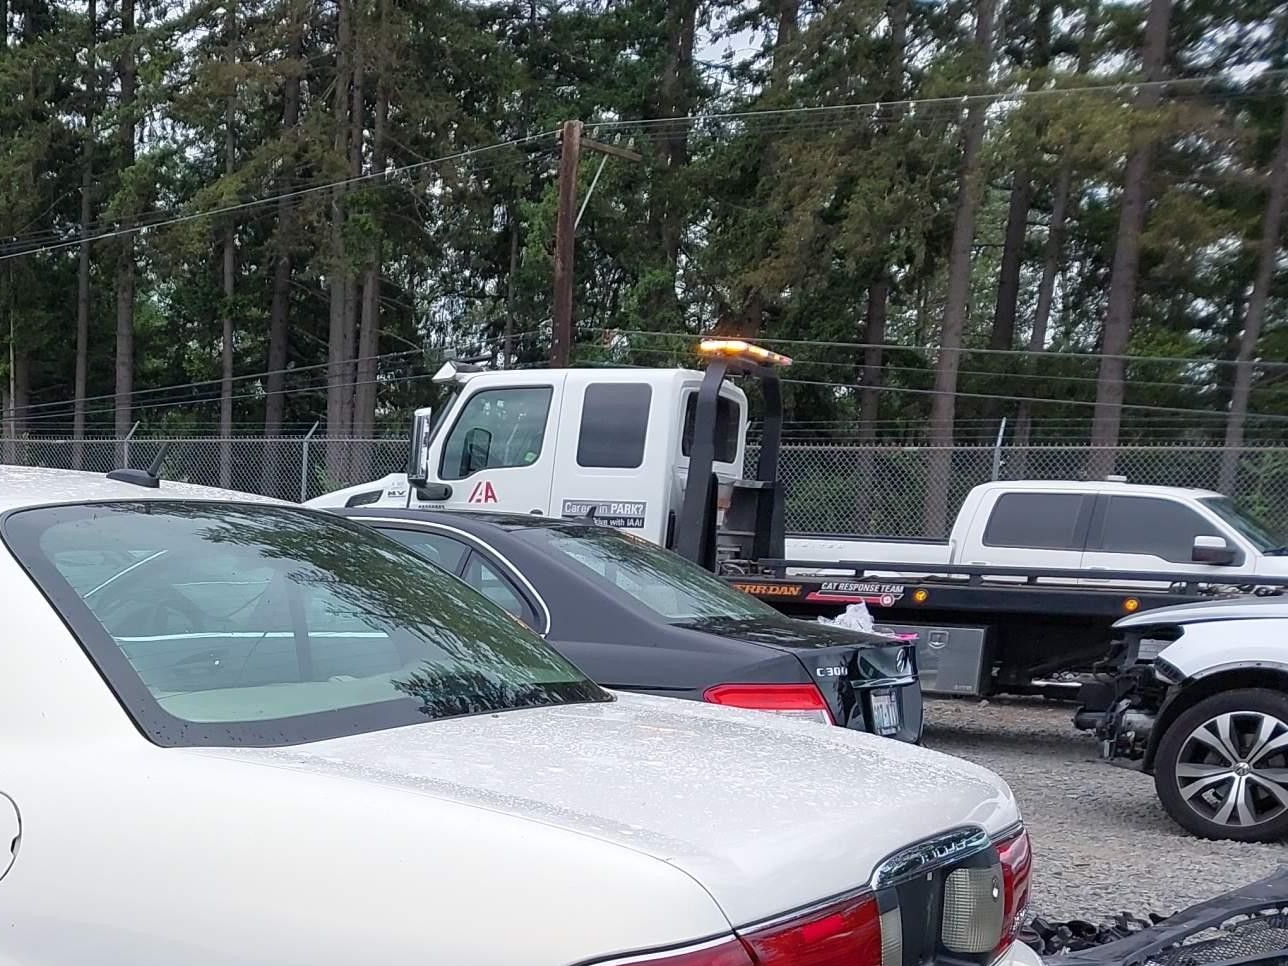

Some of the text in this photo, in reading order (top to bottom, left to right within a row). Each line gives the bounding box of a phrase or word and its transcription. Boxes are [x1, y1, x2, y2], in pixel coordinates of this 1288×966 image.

[599, 503, 608, 513] in
[611, 503, 644, 515] PARK?
[609, 518, 625, 527] with
[821, 582, 904, 593] CAT RESPONSE TEAM
